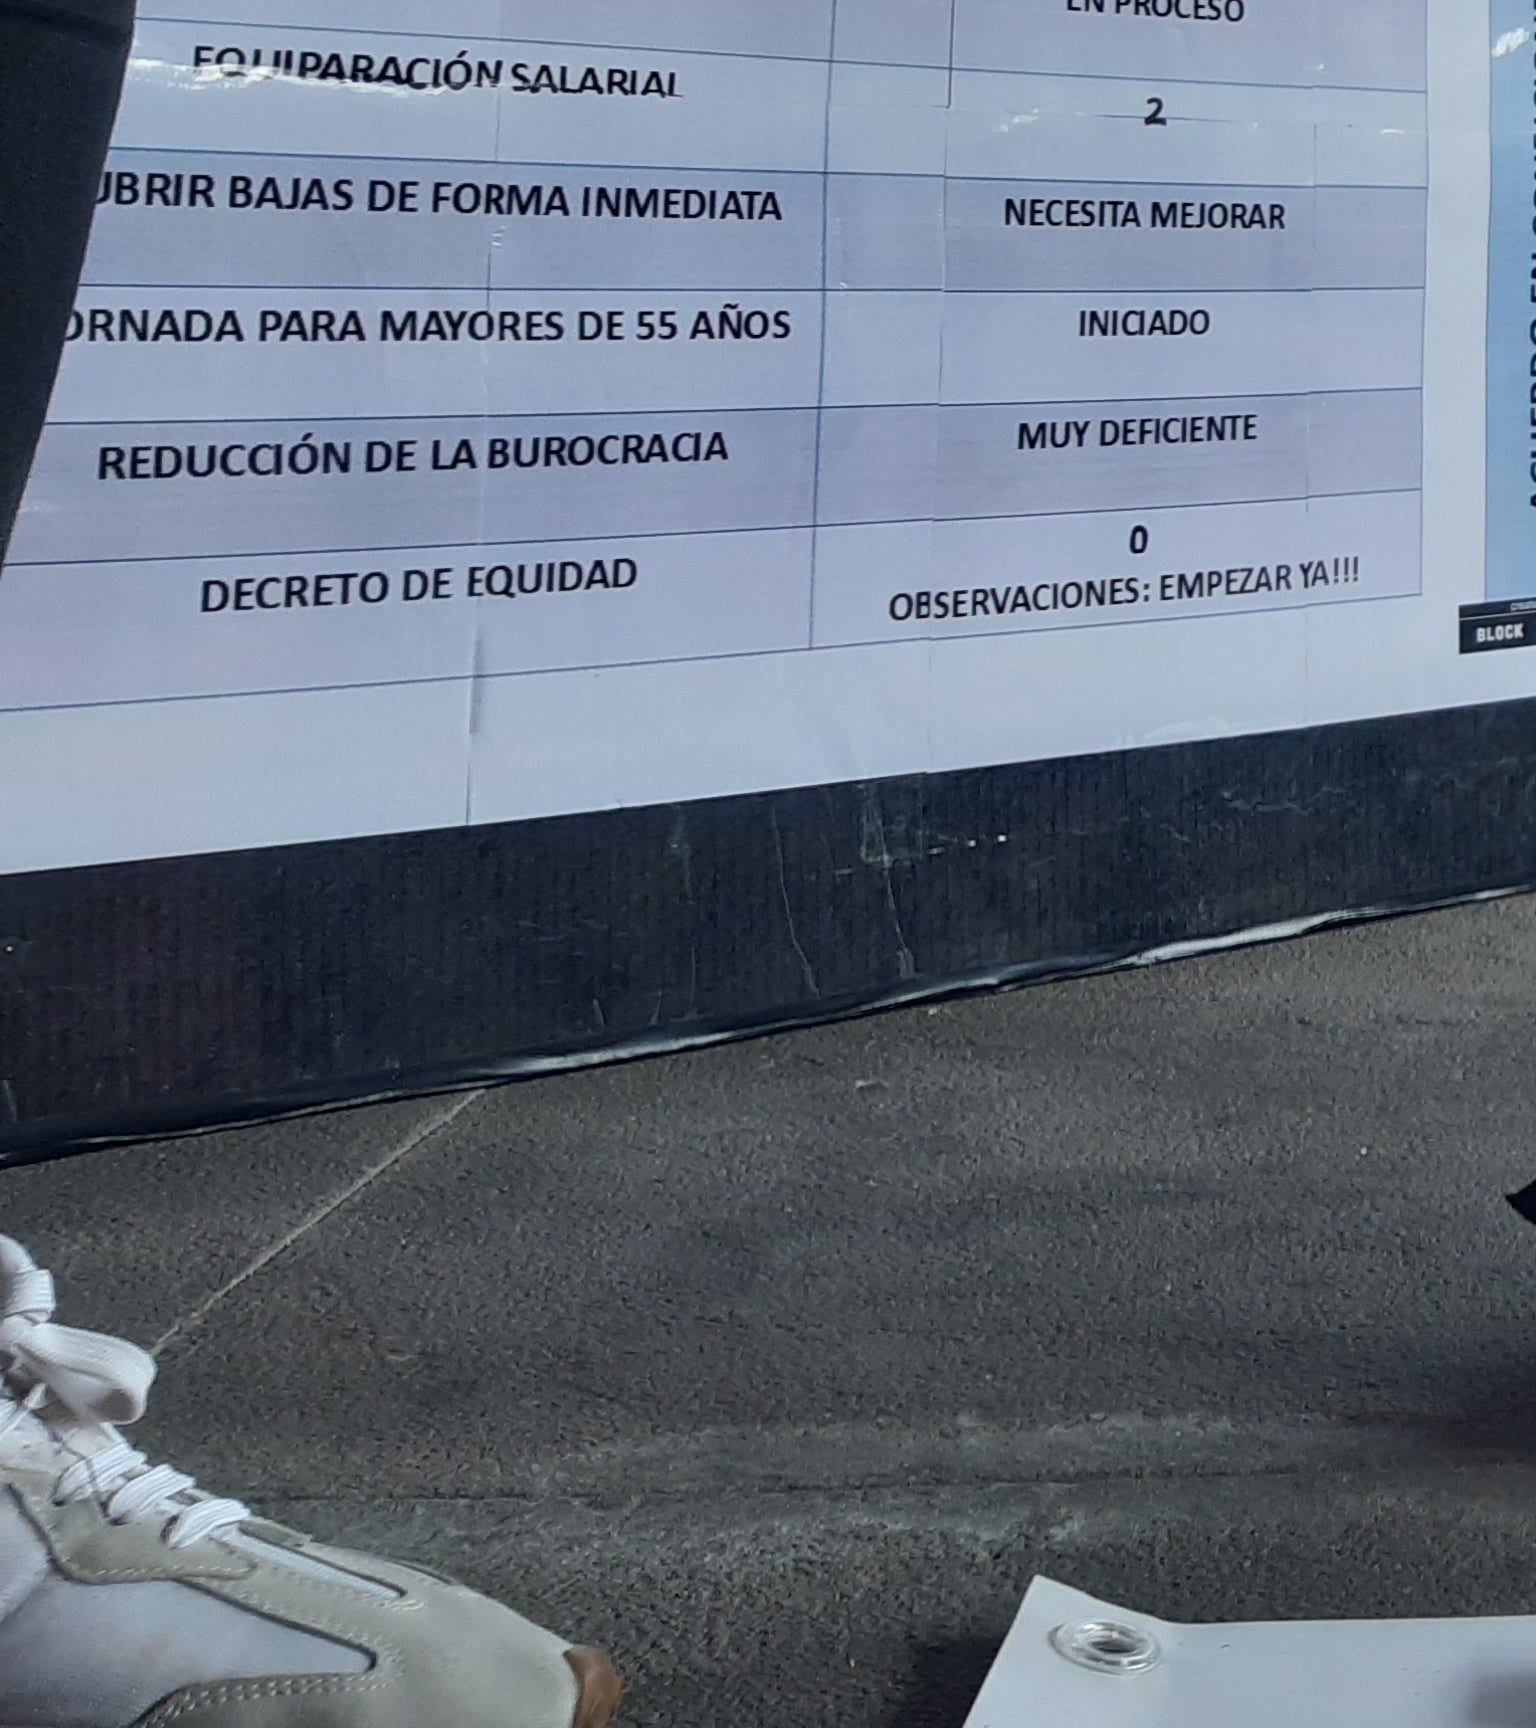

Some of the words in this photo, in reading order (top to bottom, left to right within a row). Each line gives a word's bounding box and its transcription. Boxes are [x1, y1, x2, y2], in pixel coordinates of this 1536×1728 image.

[193, 44, 503, 92] EQUIPARACIÓN
[511, 61, 684, 99] SALARIAL
[1143, 97, 1168, 127] 2
[95, 172, 216, 209] UBRIR
[228, 176, 354, 214] BAJAS
[367, 179, 418, 214] DE
[431, 182, 570, 218] FORMA
[582, 186, 783, 222] INMEDIATA
[1004, 197, 1142, 229] NECESITA
[1149, 200, 1286, 232] MEJORAR
[65, 308, 244, 344] ORNADA
[258, 309, 366, 343] PARA
[379, 309, 565, 343] MAYORES
[578, 310, 624, 341] DE
[636, 310, 678, 341] 55
[689, 301, 792, 341] AÑOS
[1078, 309, 1211, 338] INICIADO
[1016, 420, 1091, 451] MUY
[1099, 413, 1258, 447] DEFICIENTE
[97, 432, 351, 481] REDUCCIÓN
[364, 440, 417, 473] DE
[431, 438, 477, 472] LA
[487, 431, 729, 470] BUROCRACIA
[1129, 525, 1149, 556] 0
[200, 570, 389, 614] DECRETO
[402, 568, 452, 602] DE
[467, 557, 639, 601] EQUIDAD
[888, 578, 1152, 623] OBSERVACIONES:
[1160, 564, 1293, 603] EMPEZAR
[1300, 557, 1361, 591] YA!!!
[1476, 623, 1524, 643] BLOCK
